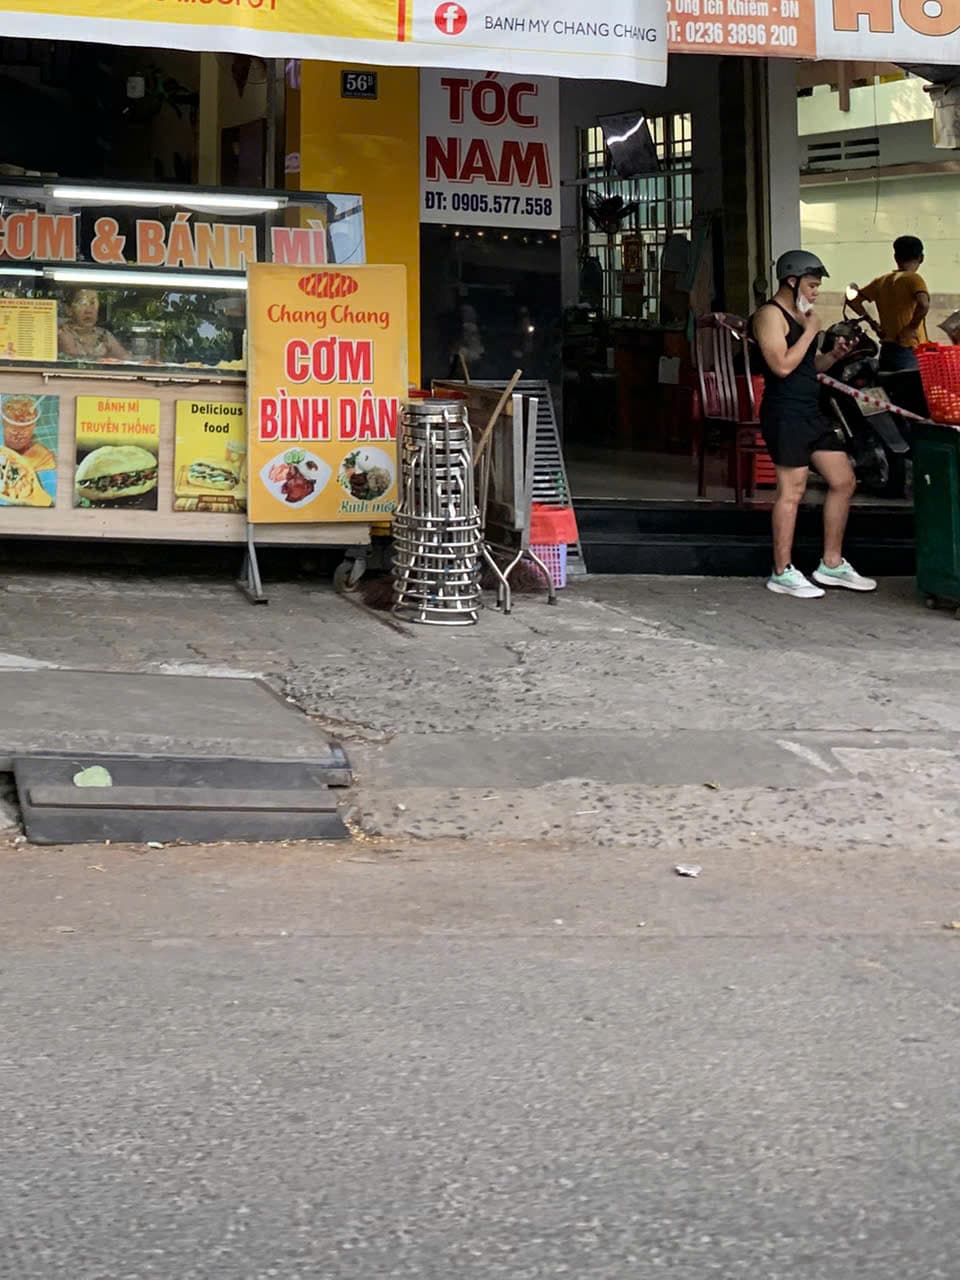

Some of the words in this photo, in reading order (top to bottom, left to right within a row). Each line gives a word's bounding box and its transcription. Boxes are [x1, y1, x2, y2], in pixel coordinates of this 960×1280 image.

[780, 0, 800, 18] ĐN
[485, 16, 525, 31] BANH
[529, 19, 550, 33] MY
[553, 21, 609, 37] CHANG
[613, 24, 657, 42] CHANG
[685, 21, 723, 43] 0236
[728, 23, 766, 45] 3896
[770, 25, 797, 47] 200
[441, 71, 538, 128] TÓC
[425, 135, 553, 188] NAM
[425, 191, 447, 211] ĐT:
[452, 193, 553, 216] 0905.577.558
[91, 217, 126, 263] &
[136, 212, 257, 269] BÁNH
[271, 220, 328, 264] MÌ
[267, 304, 327, 329] Chang
[331, 305, 390, 329] Chang
[285, 335, 375, 383] CƠM
[98, 401, 125, 413] BÁNH
[128, 400, 139, 413] MÌ
[191, 404, 243, 416] Delicious
[259, 390, 330, 442] BÌNH
[340, 390, 400, 442] DÂN
[204, 422, 230, 433] food
